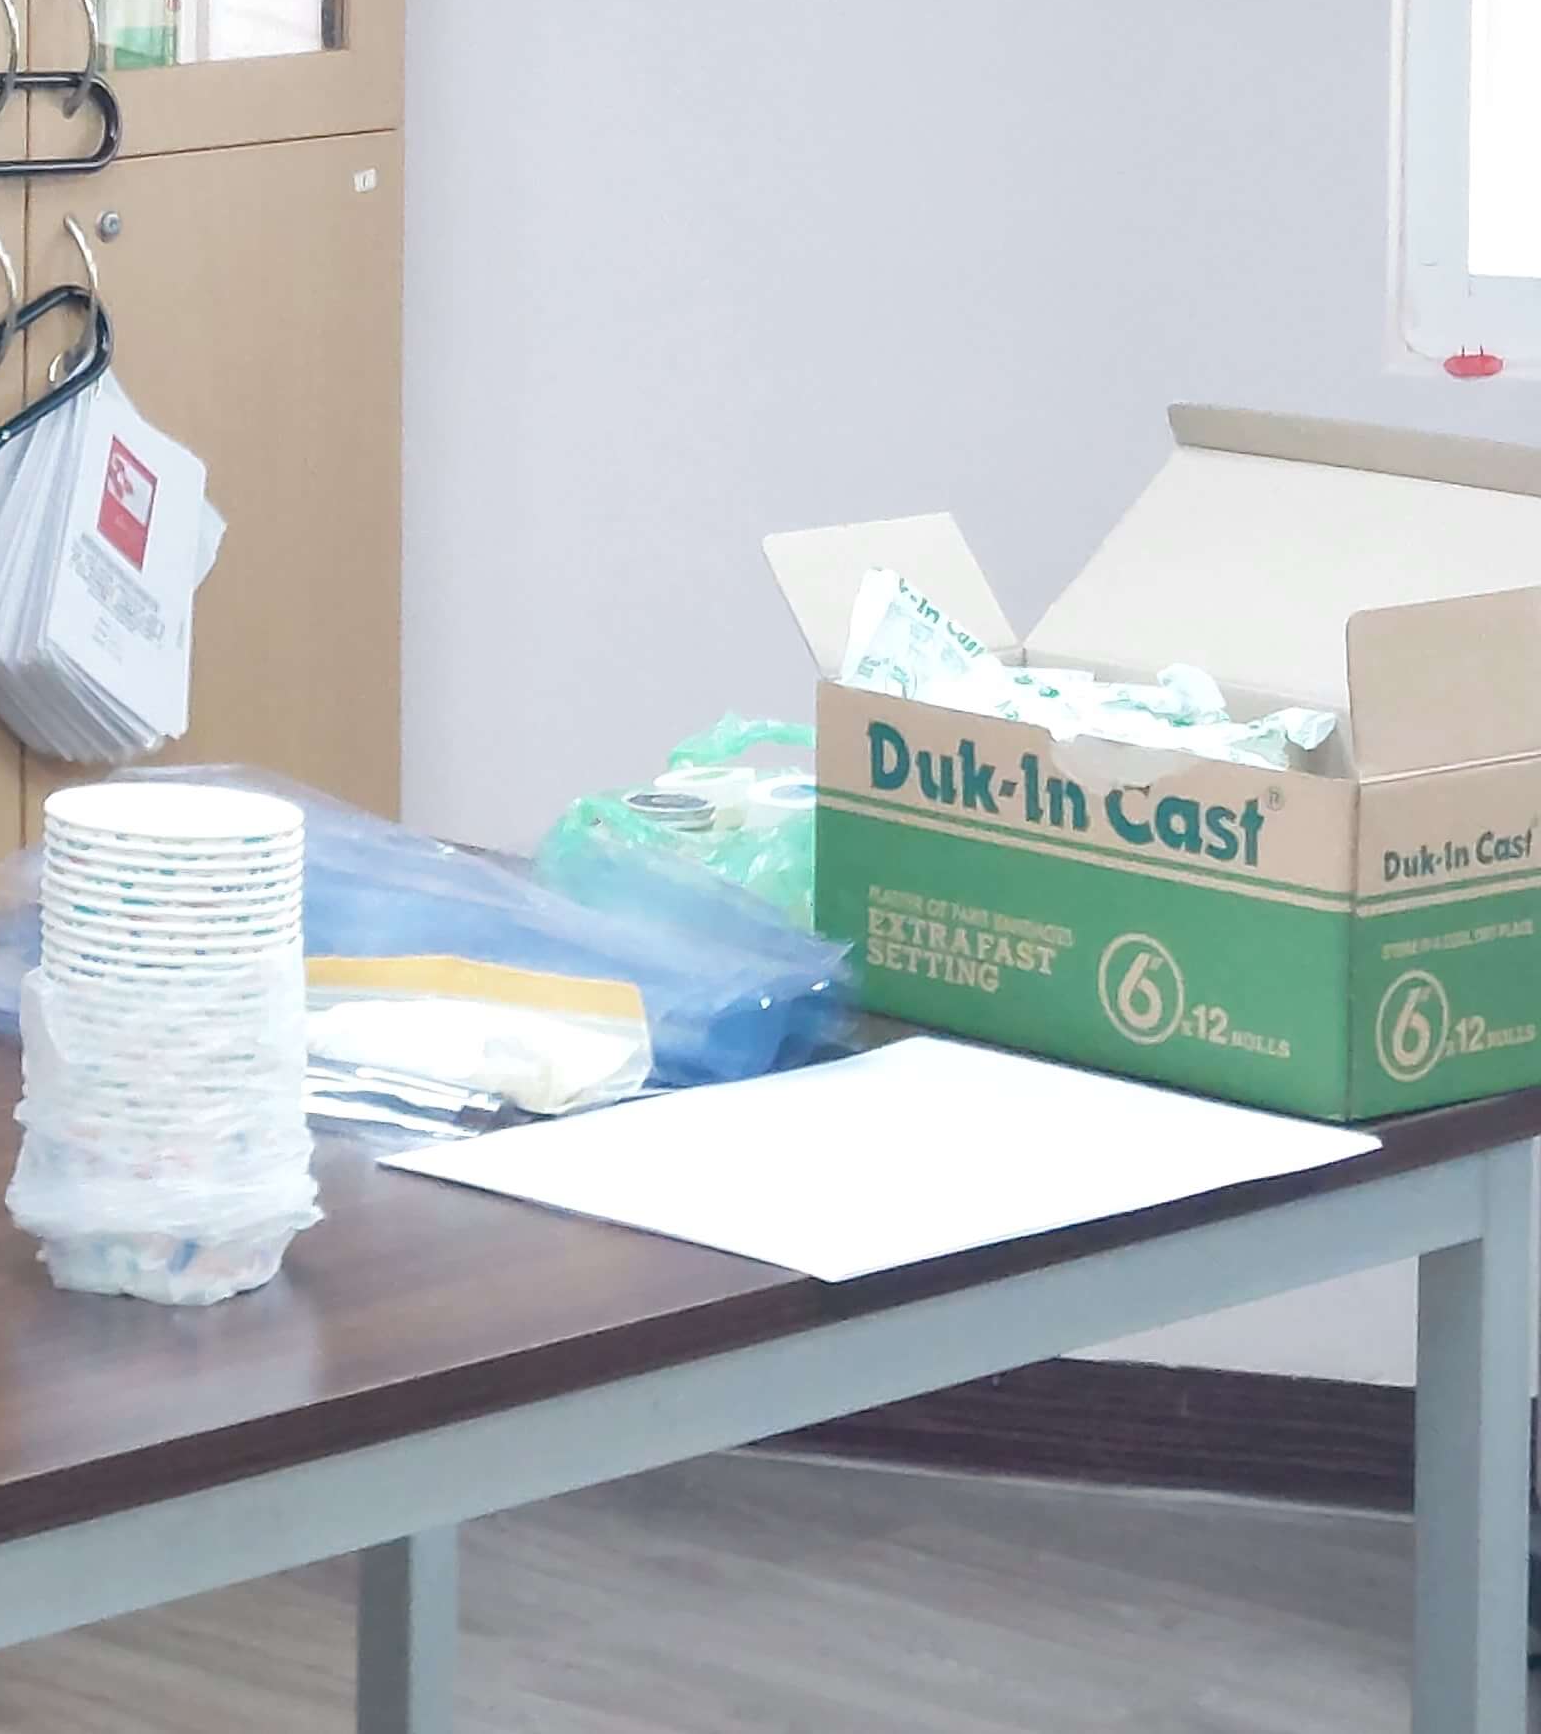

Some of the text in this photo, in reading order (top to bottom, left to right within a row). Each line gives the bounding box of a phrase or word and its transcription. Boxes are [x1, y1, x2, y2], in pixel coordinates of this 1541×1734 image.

[868, 721, 1264, 867] Duk-In Cast
[1383, 829, 1533, 882] Duk-In Cast
[867, 937, 999, 993] SETTING
[868, 907, 1056, 975] EXTRA FAST
